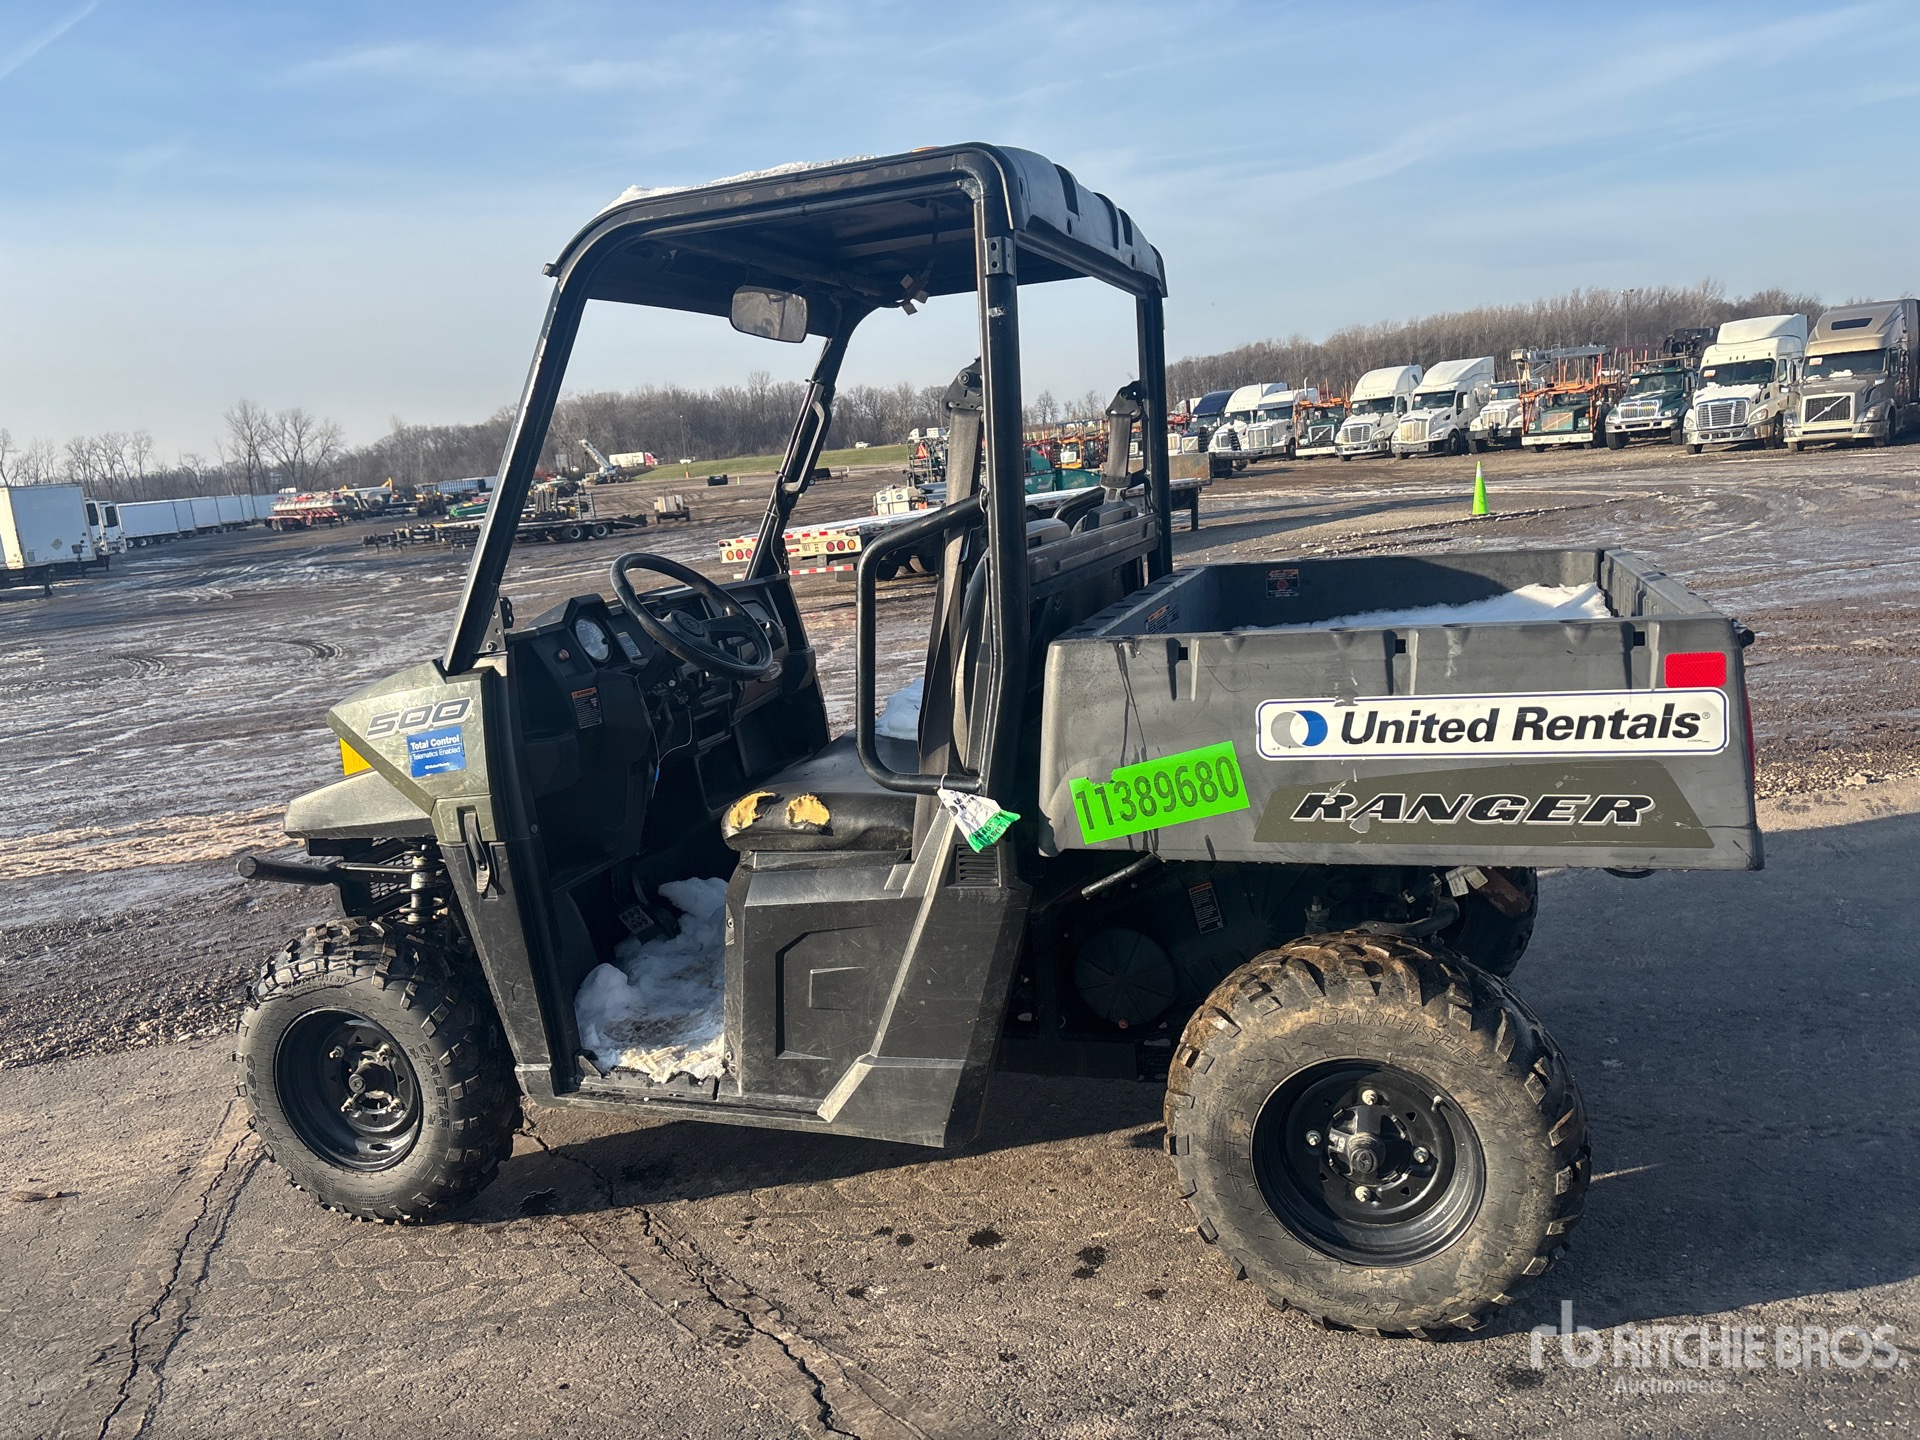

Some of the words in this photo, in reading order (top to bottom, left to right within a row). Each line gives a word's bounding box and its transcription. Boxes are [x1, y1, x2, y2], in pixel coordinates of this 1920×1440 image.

[366, 697, 472, 740] 500
[1341, 707, 1500, 744] United
[1511, 703, 1701, 741] Rentals
[410, 739, 429, 751] Total
[430, 733, 460, 747] Control
[412, 750, 439, 761] Telematics
[439, 746, 461, 756] Enabled
[1075, 756, 1239, 830] 11389680
[1290, 792, 1656, 826] RANGER
[417, 1042, 451, 1132] CARLSTAR
